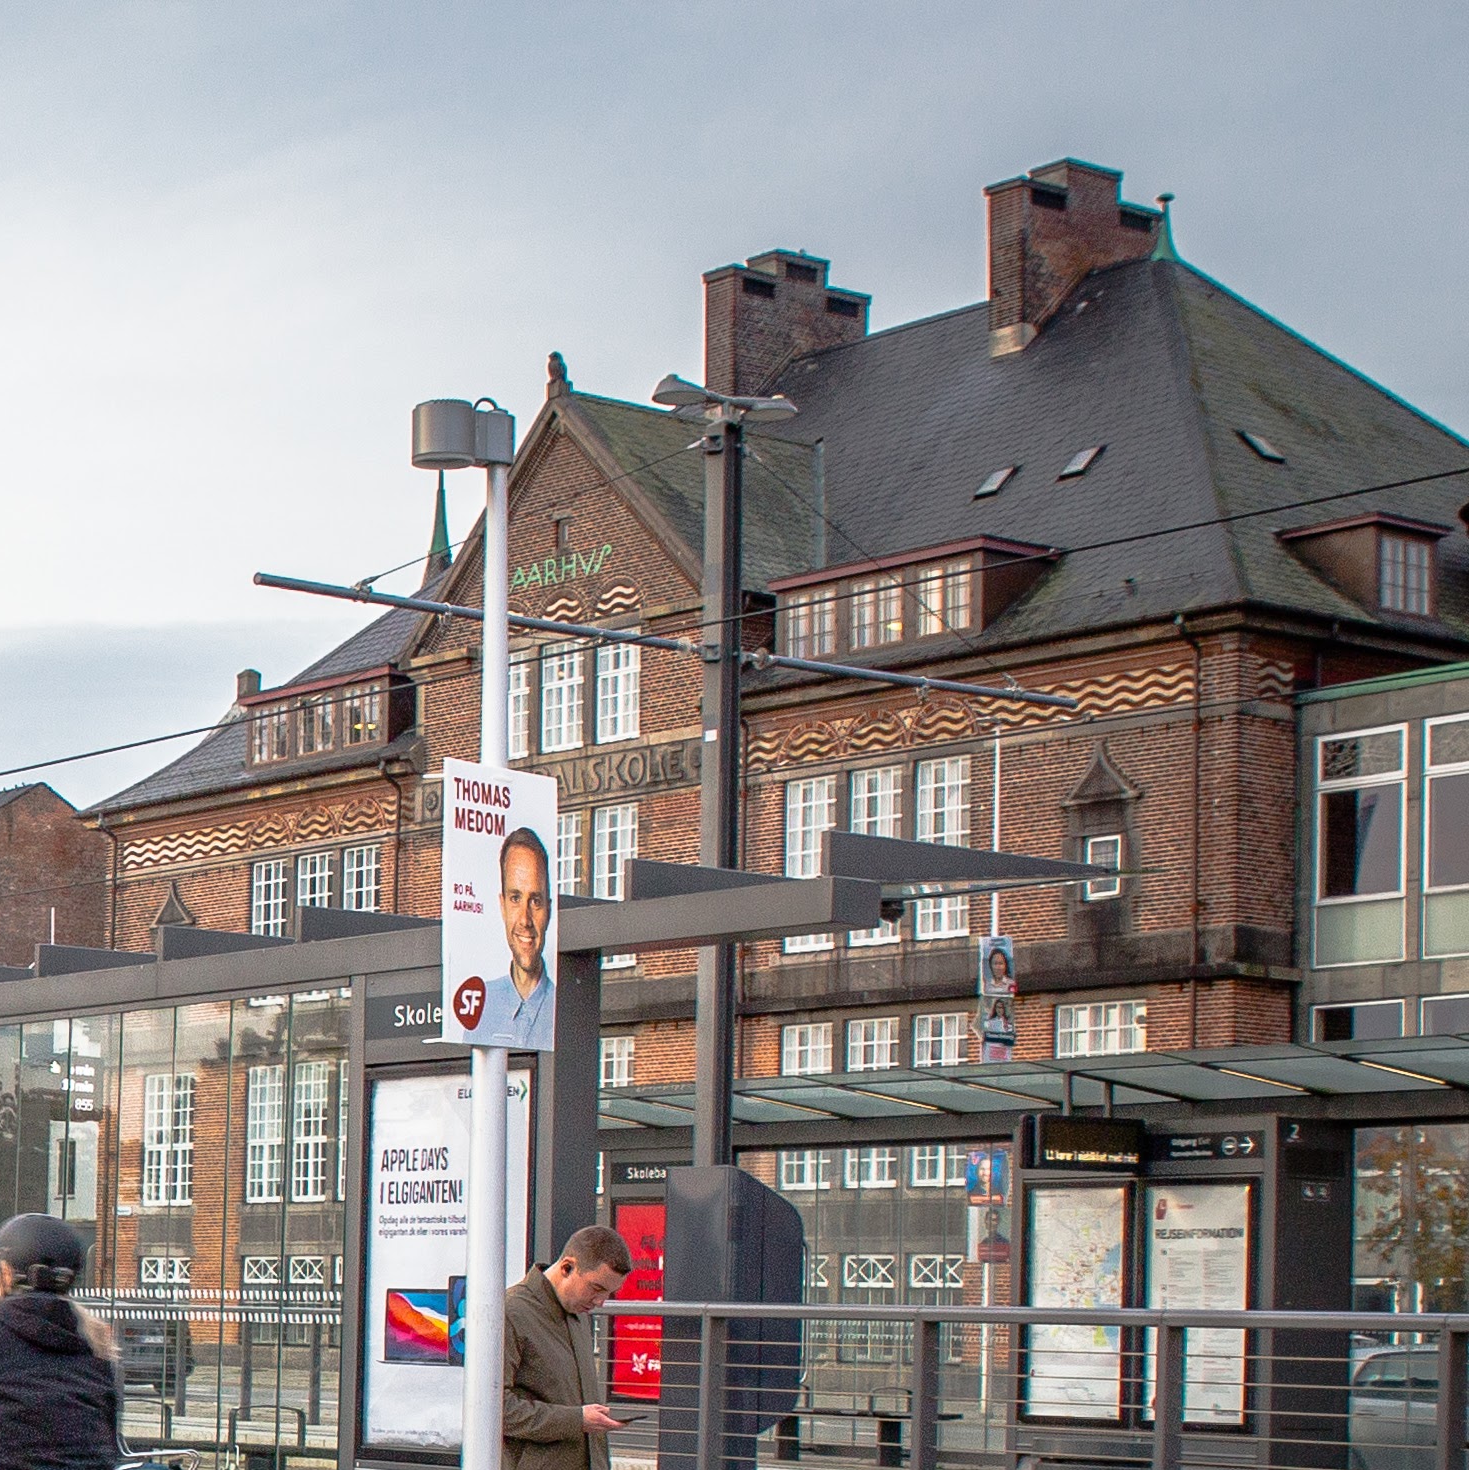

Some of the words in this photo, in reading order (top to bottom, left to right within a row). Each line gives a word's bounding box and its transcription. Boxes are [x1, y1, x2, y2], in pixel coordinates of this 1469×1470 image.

[454, 777, 511, 809] THOMAS
[455, 807, 506, 836] MEDOM
[453, 899, 484, 914] AARHUS!
[460, 989, 482, 1016] SF
[393, 1003, 443, 1028] Skole
[381, 1148, 419, 1172] APPLE
[420, 1146, 449, 1171] DAYS
[627, 1166, 667, 1180] Skoleba
[380, 1182, 384, 1204] I
[388, 1179, 463, 1204] ELGIGANTEN!
[449, 1227, 468, 1236] vareh
